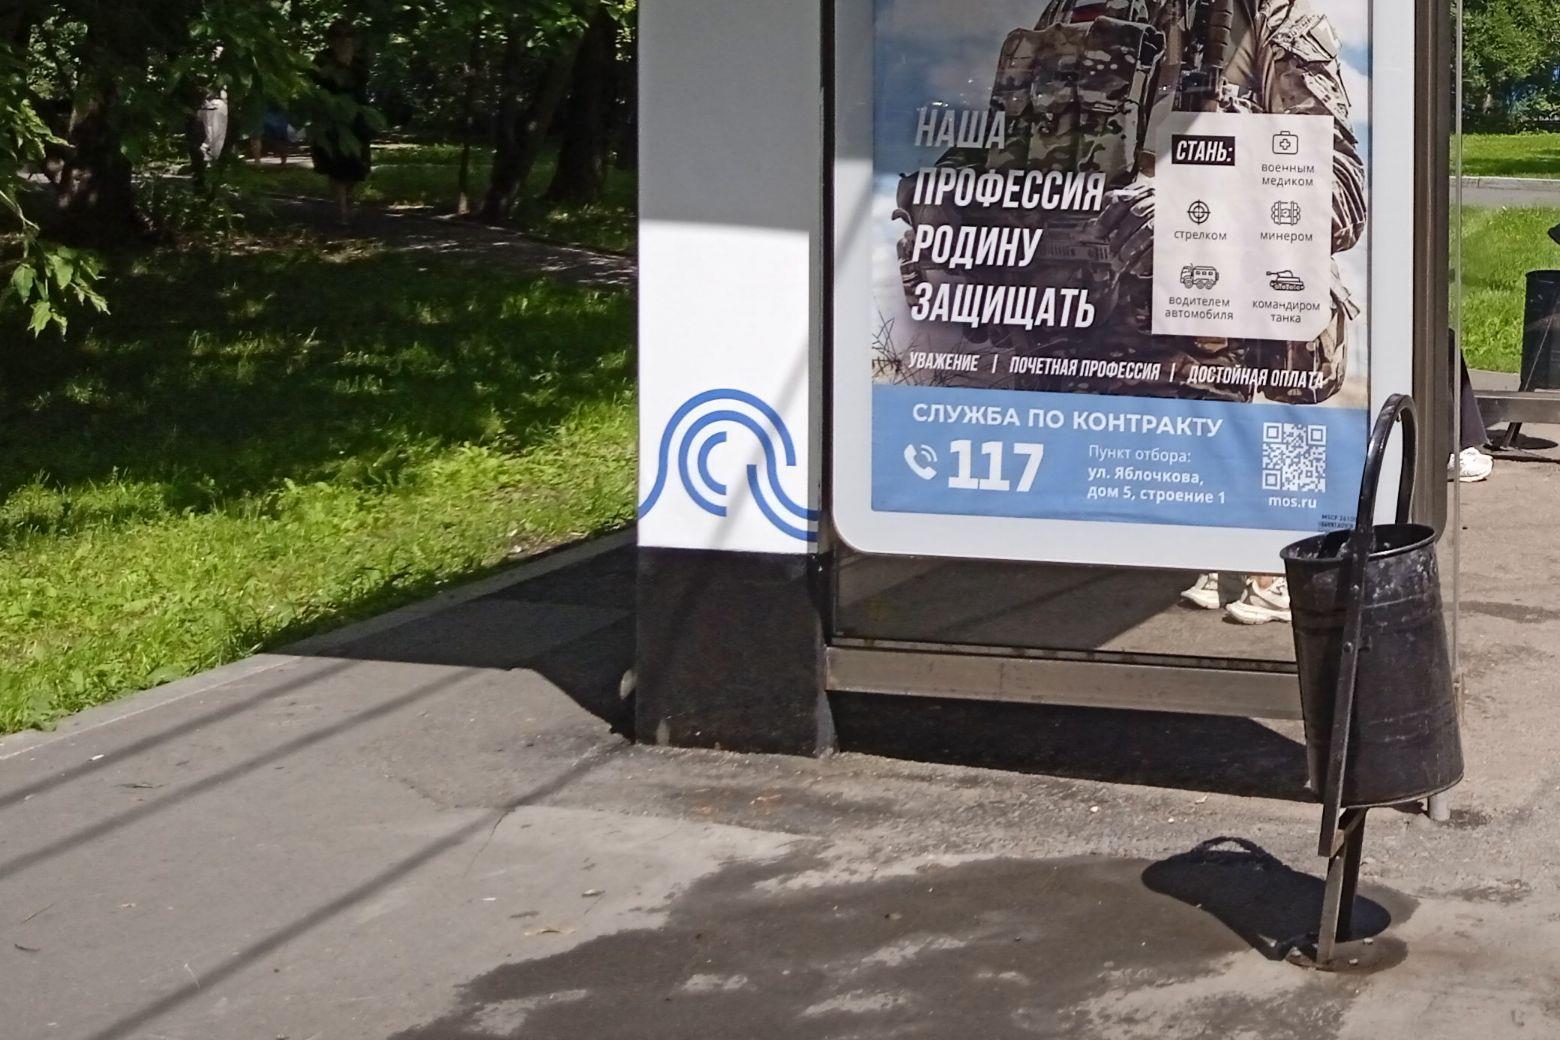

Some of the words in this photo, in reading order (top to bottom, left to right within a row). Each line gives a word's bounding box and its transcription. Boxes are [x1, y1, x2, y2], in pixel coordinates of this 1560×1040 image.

[914, 109, 1006, 150] НАША
[1176, 139, 1233, 163] СТАНЬ:
[1261, 164, 1315, 174] военным
[912, 166, 1107, 211] ПРОФЕССИЯ
[1262, 176, 1314, 187] медиком
[1174, 230, 1227, 241] стрелком
[1260, 231, 1313, 242] минером
[912, 224, 1043, 269] РОДИНУ
[910, 282, 1096, 330] ЗАЩИЩАТЬ
[1168, 296, 1230, 307] водителем
[1252, 301, 1320, 312] командиром
[1164, 307, 1234, 321] автомобиля
[1270, 313, 1302, 324] танка
[908, 351, 980, 372] УВАЖЕНИЕ
[1009, 356, 1077, 376] ПОЧЕТНАЯ
[1079, 360, 1161, 382] ПРОФЕССИЯ
[1186, 364, 1268, 387] ДОСТОЙНАЯ
[1270, 369, 1324, 389] ОПЛАТА
[912, 403, 1021, 426] СЛУЖБА
[1028, 409, 1064, 428] ПО
[1073, 411, 1223, 437] КОНТРАКТУ
[1089, 445, 1130, 462] Пункт
[1135, 446, 1192, 465] отбора:
[948, 439, 1044, 492] 117
[1087, 467, 1111, 482] ул.
[1114, 467, 1204, 486] Яблочкова,
[1087, 486, 1119, 500] дом
[1123, 486, 1136, 502] 5,
[1140, 489, 1214, 504] строение
[1218, 491, 1225, 504] 1
[1268, 495, 1317, 509] mos.ru
